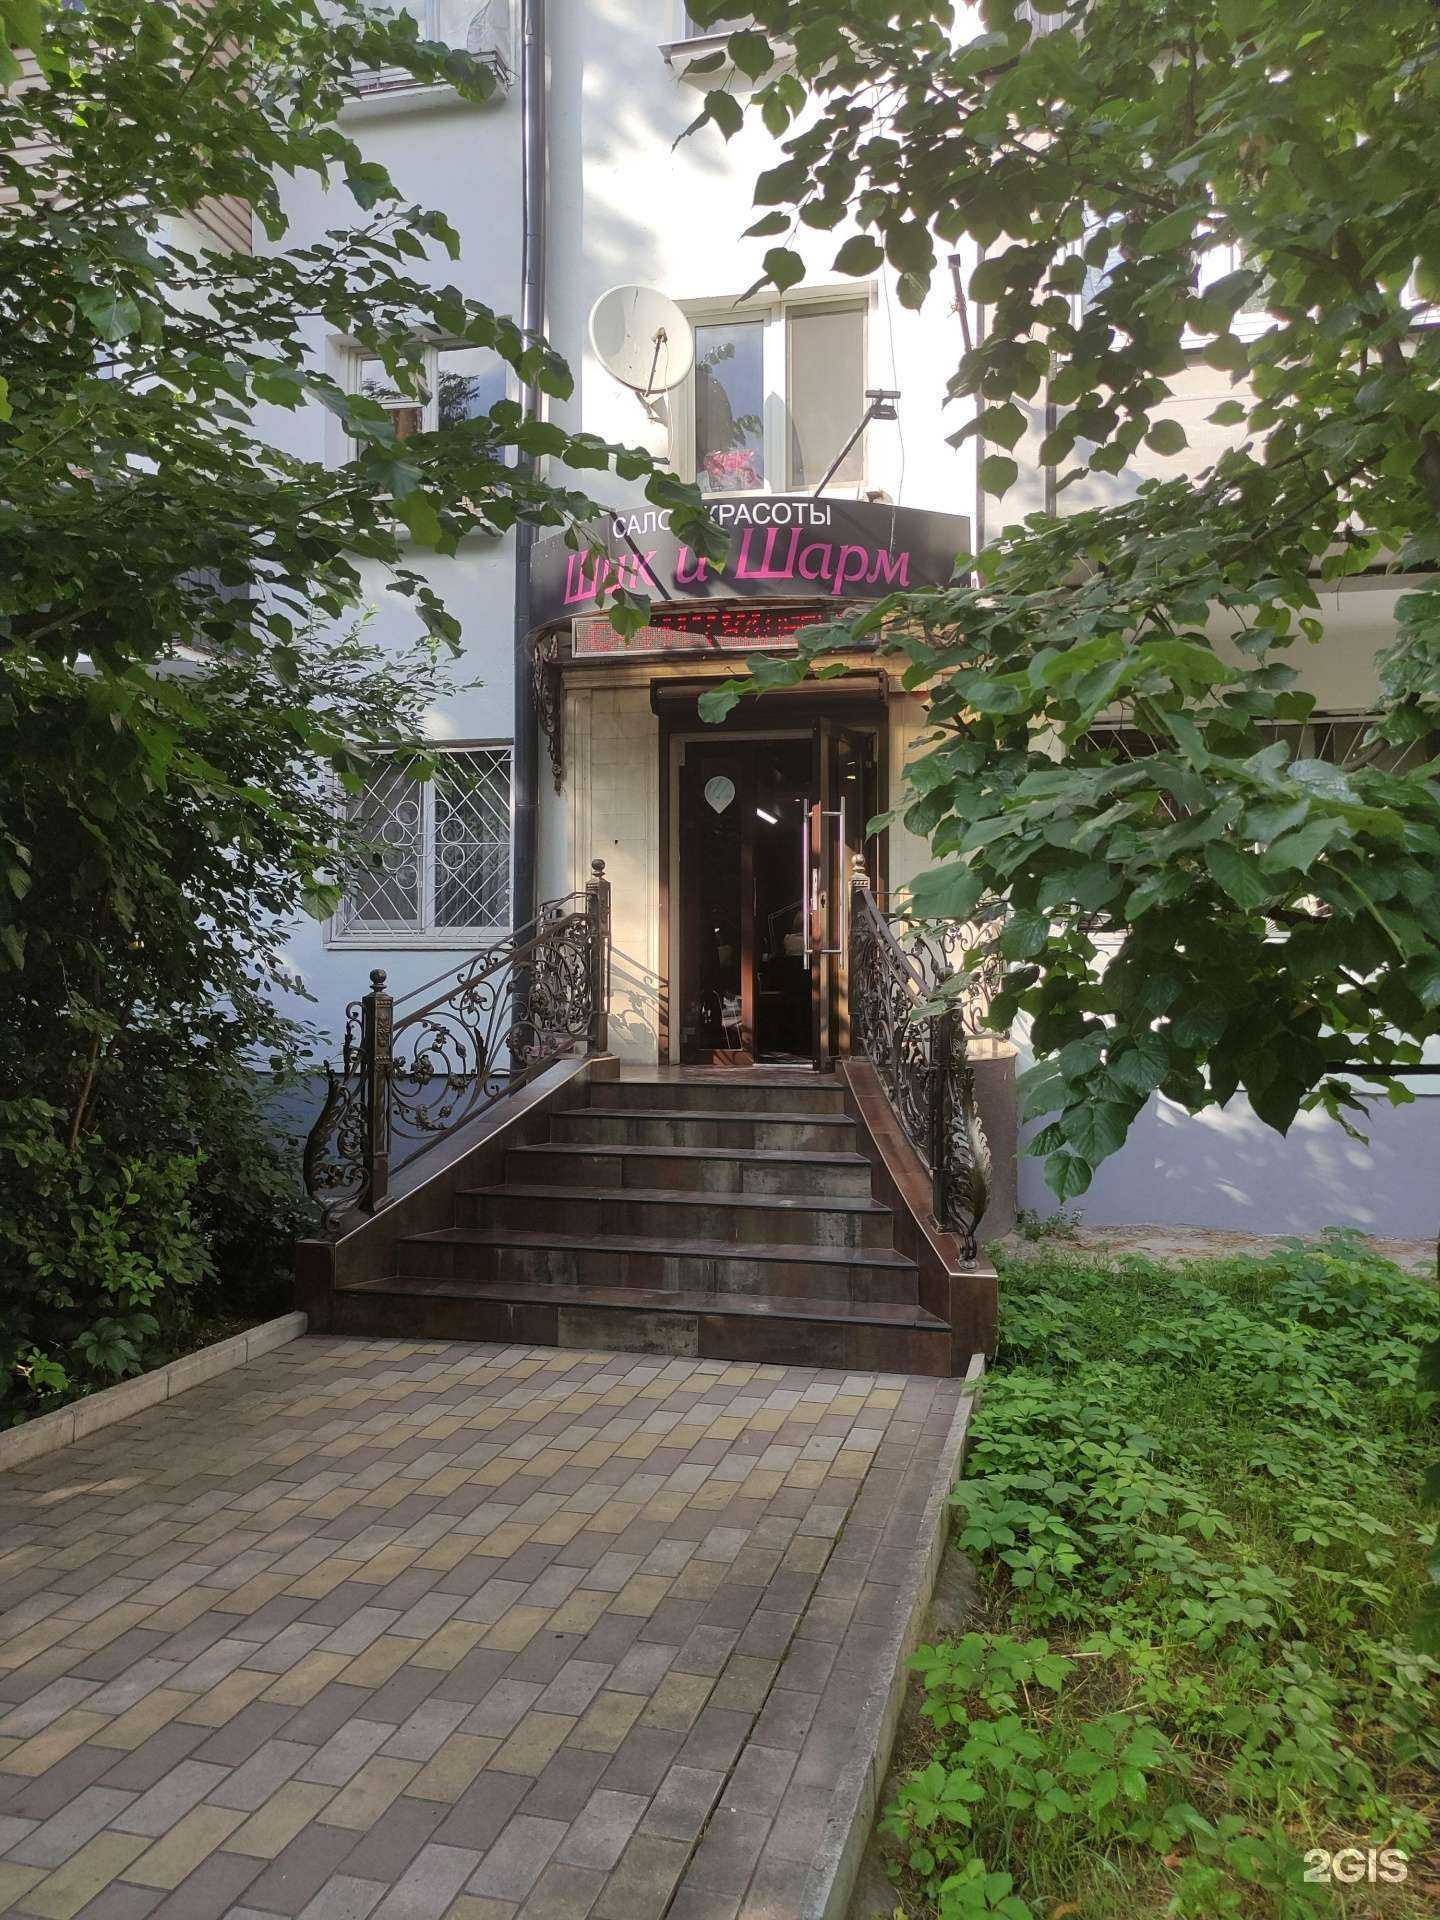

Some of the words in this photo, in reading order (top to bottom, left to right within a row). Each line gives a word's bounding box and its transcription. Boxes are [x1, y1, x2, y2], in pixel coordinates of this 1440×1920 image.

[612, 509, 674, 538] САЛО
[674, 546, 709, 584] и
[734, 527, 911, 596] Шарм
